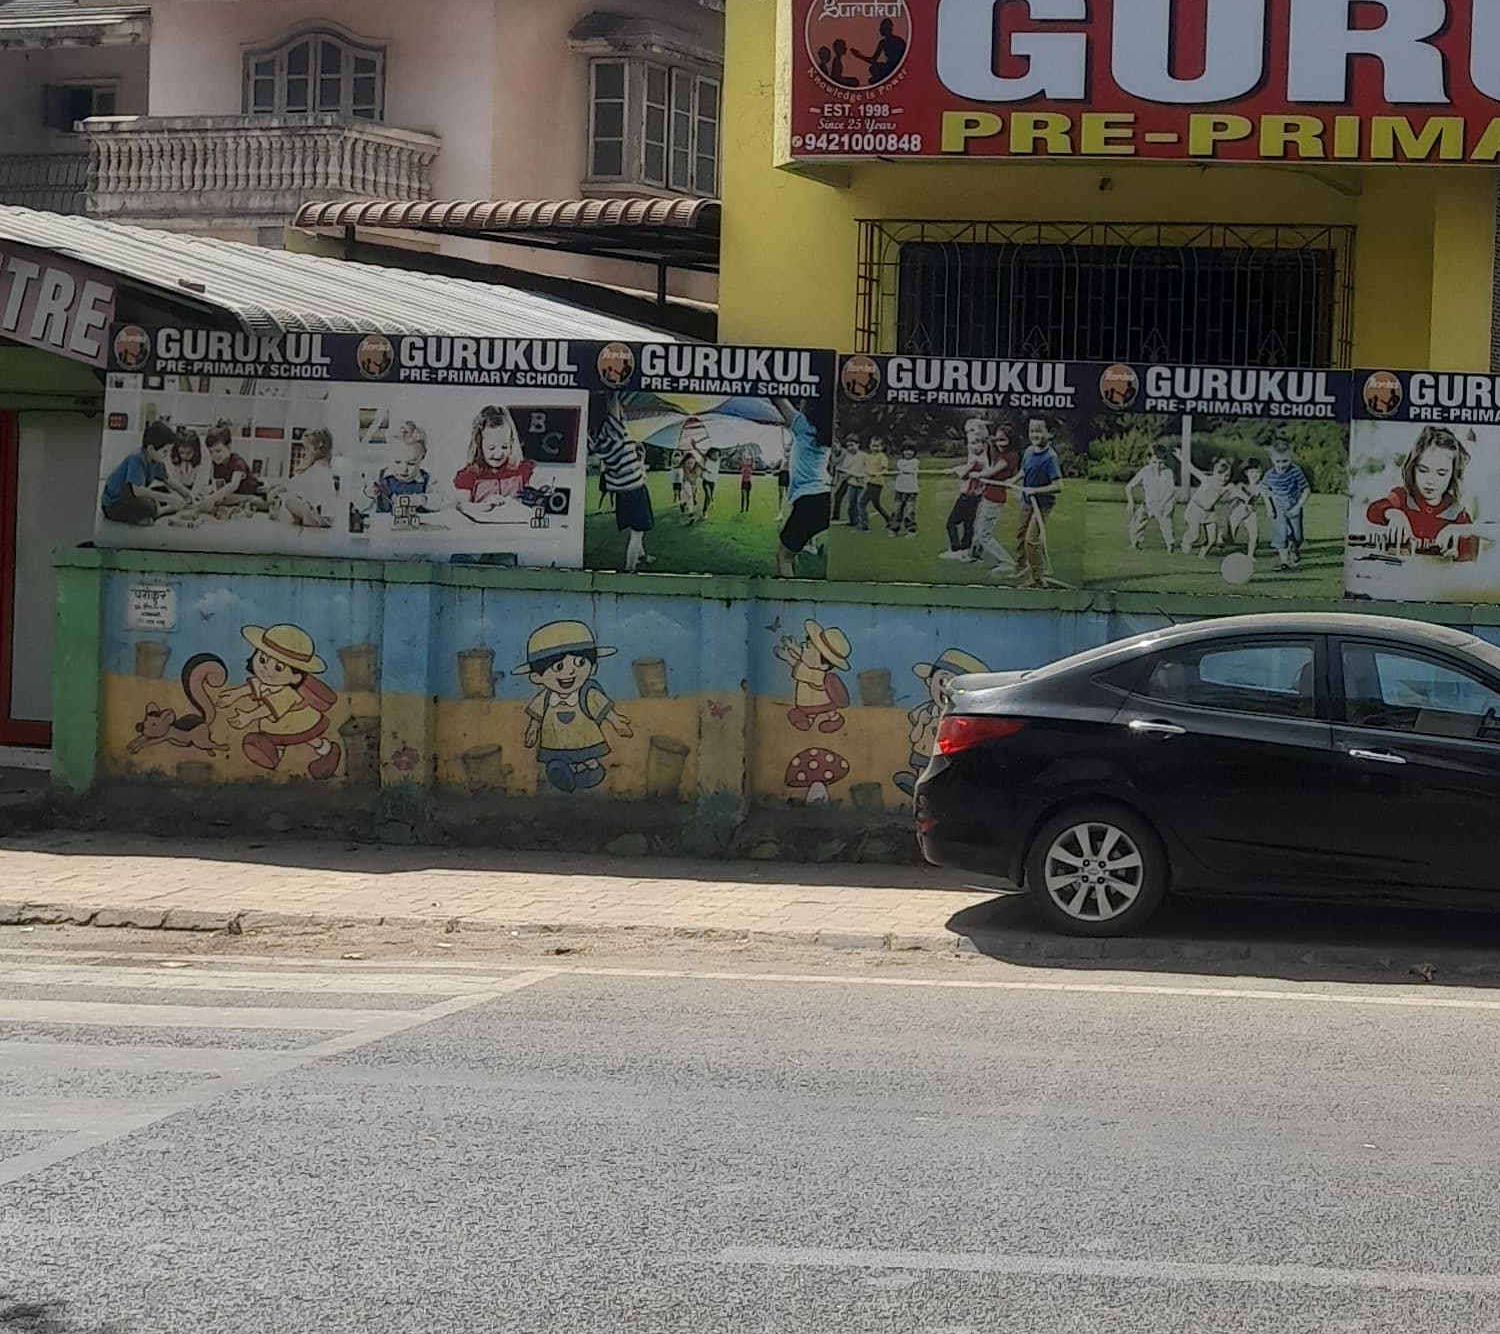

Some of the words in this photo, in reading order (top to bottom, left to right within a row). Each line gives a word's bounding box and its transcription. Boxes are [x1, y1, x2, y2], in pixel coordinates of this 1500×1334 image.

[824, 104, 853, 116] EST.
[859, 104, 889, 116] 1998
[818, 118, 845, 130] Since
[848, 118, 862, 130] 25
[864, 118, 897, 132] Years
[804, 133, 921, 151] 9421000848
[0, 255, 113, 358] TRE
[156, 328, 331, 364] GURUKUL
[400, 335, 578, 371] GURUKUL
[156, 360, 269, 377] PRE-PRIMARY
[270, 363, 331, 378] SCHOOL
[641, 344, 820, 382] GURUKUL
[400, 368, 511, 385] PRE-PRIMARY
[515, 372, 578, 386] SCHOOL
[887, 357, 1075, 394] GURUKUL
[1145, 366, 1336, 403] GURUKUL
[640, 376, 753, 394] PRE-PRIMARY
[758, 382, 820, 397] SCHOOL
[887, 389, 1006, 406] PRE-PRIMARY
[1009, 394, 1075, 408] SCHOOL
[1145, 399, 1264, 415] PRE-PRIMARY
[1270, 403, 1336, 417] SCHOOL
